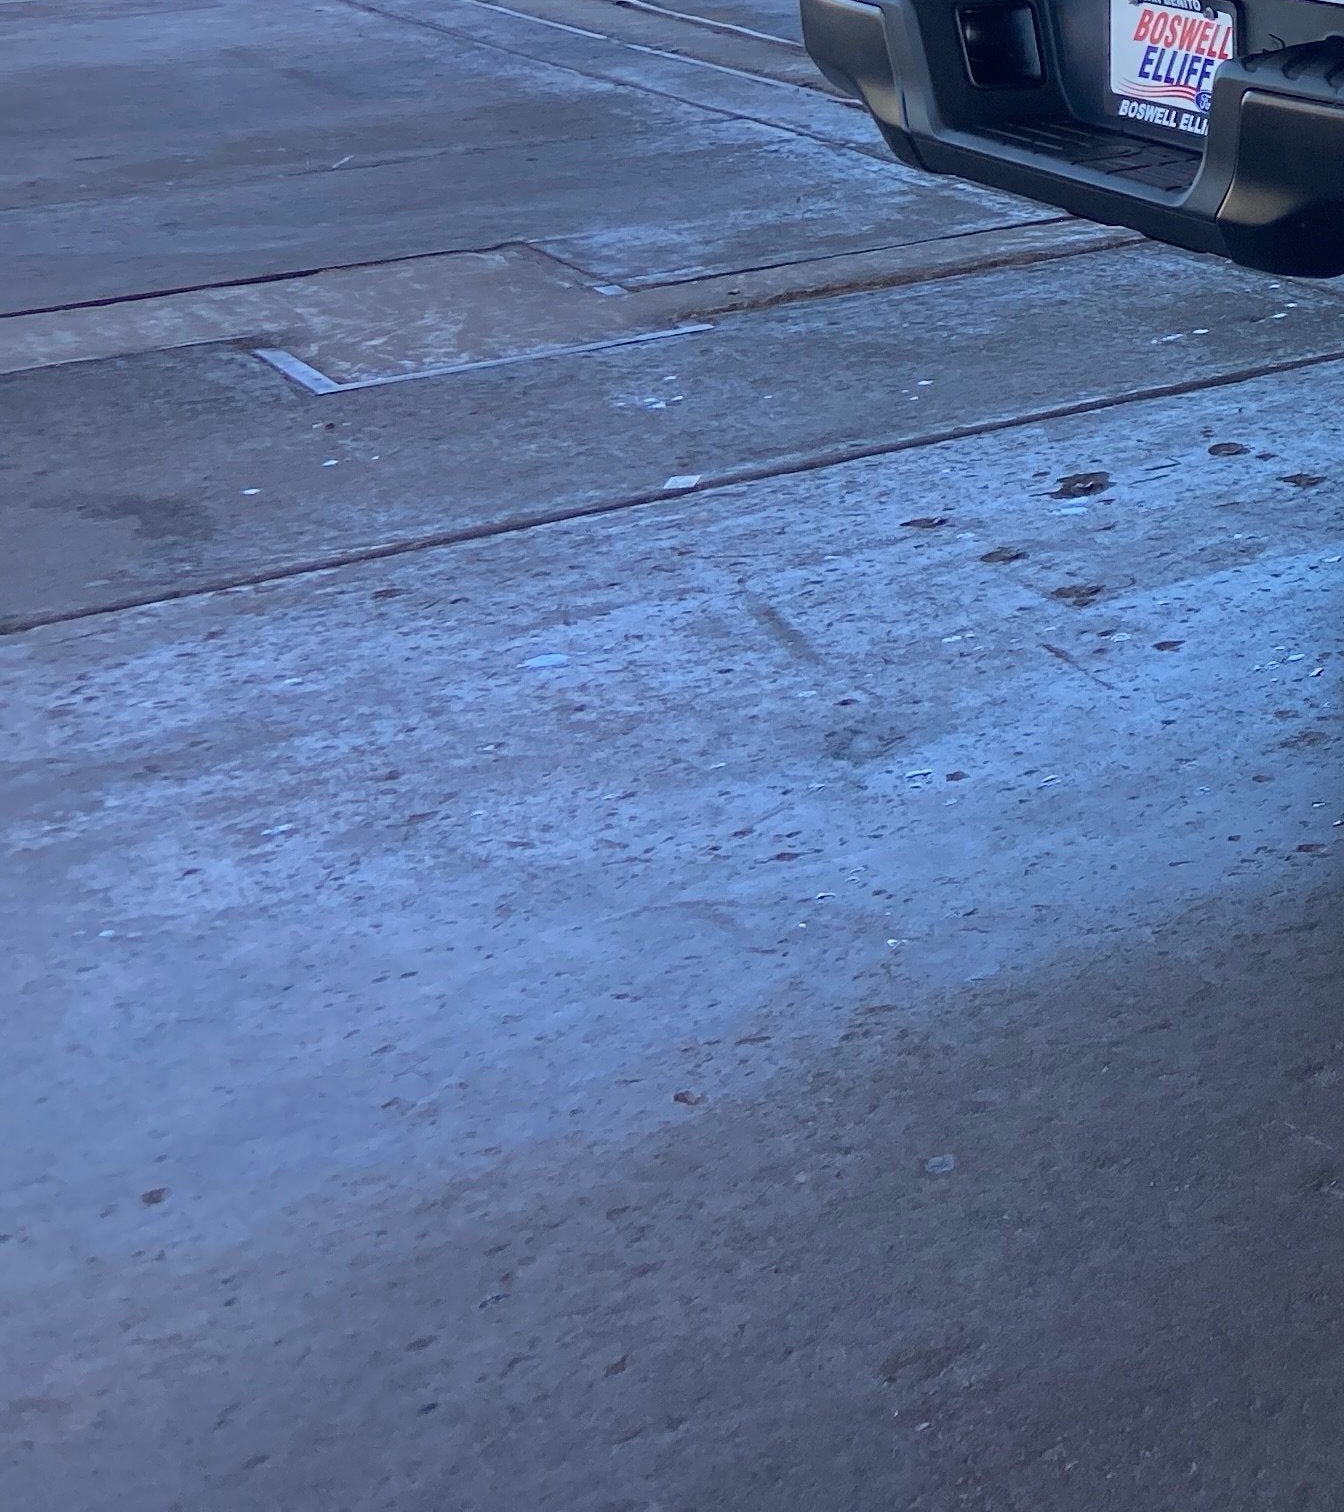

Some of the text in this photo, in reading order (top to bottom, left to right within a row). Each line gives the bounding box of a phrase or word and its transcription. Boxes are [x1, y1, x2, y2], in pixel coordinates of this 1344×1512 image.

[1133, 8, 1233, 60] BOSWELL
[1138, 45, 1215, 92] ELLIFF
[1118, 99, 1209, 137] BOSWELL ELLI
